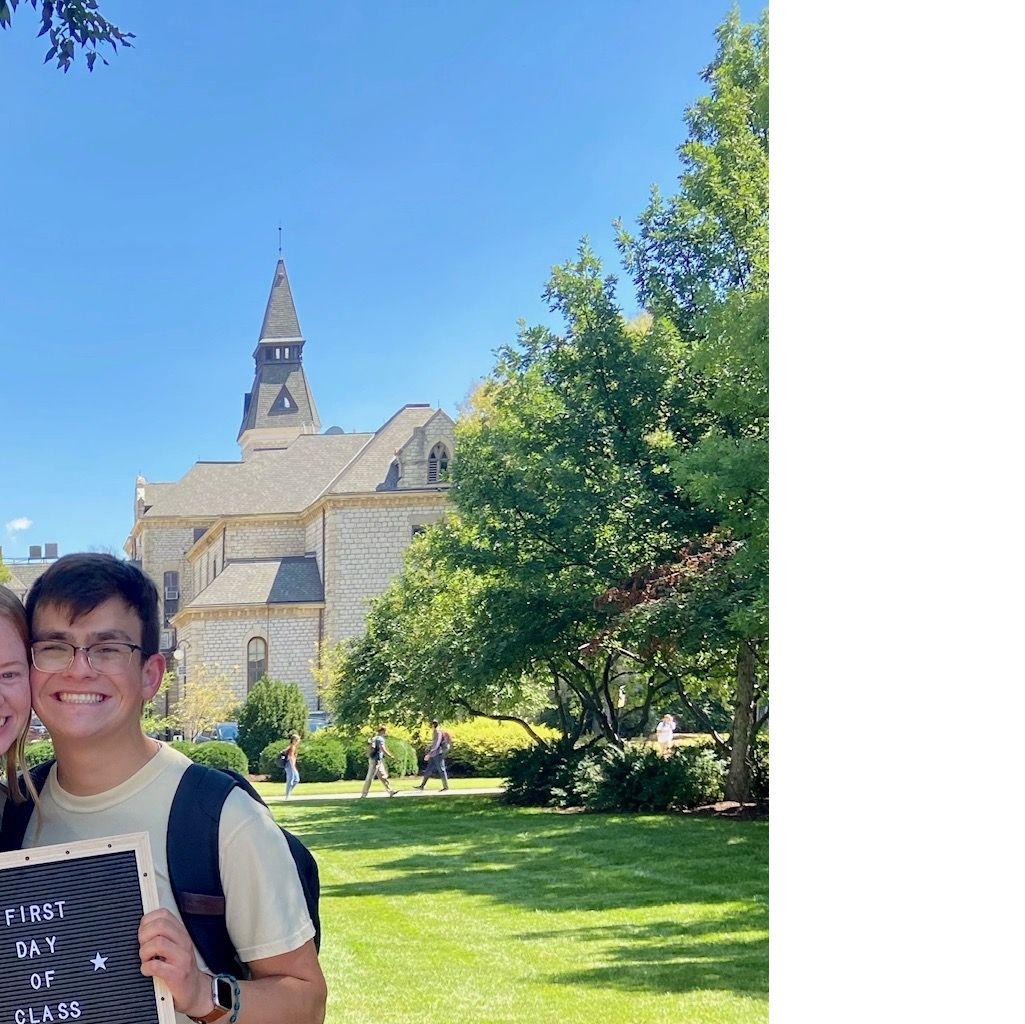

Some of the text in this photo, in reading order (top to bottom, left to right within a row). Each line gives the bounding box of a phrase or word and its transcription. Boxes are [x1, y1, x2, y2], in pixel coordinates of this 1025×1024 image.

[4, 900, 66, 927] FIRST
[15, 935, 57, 959] DAY
[30, 970, 55, 990] OF
